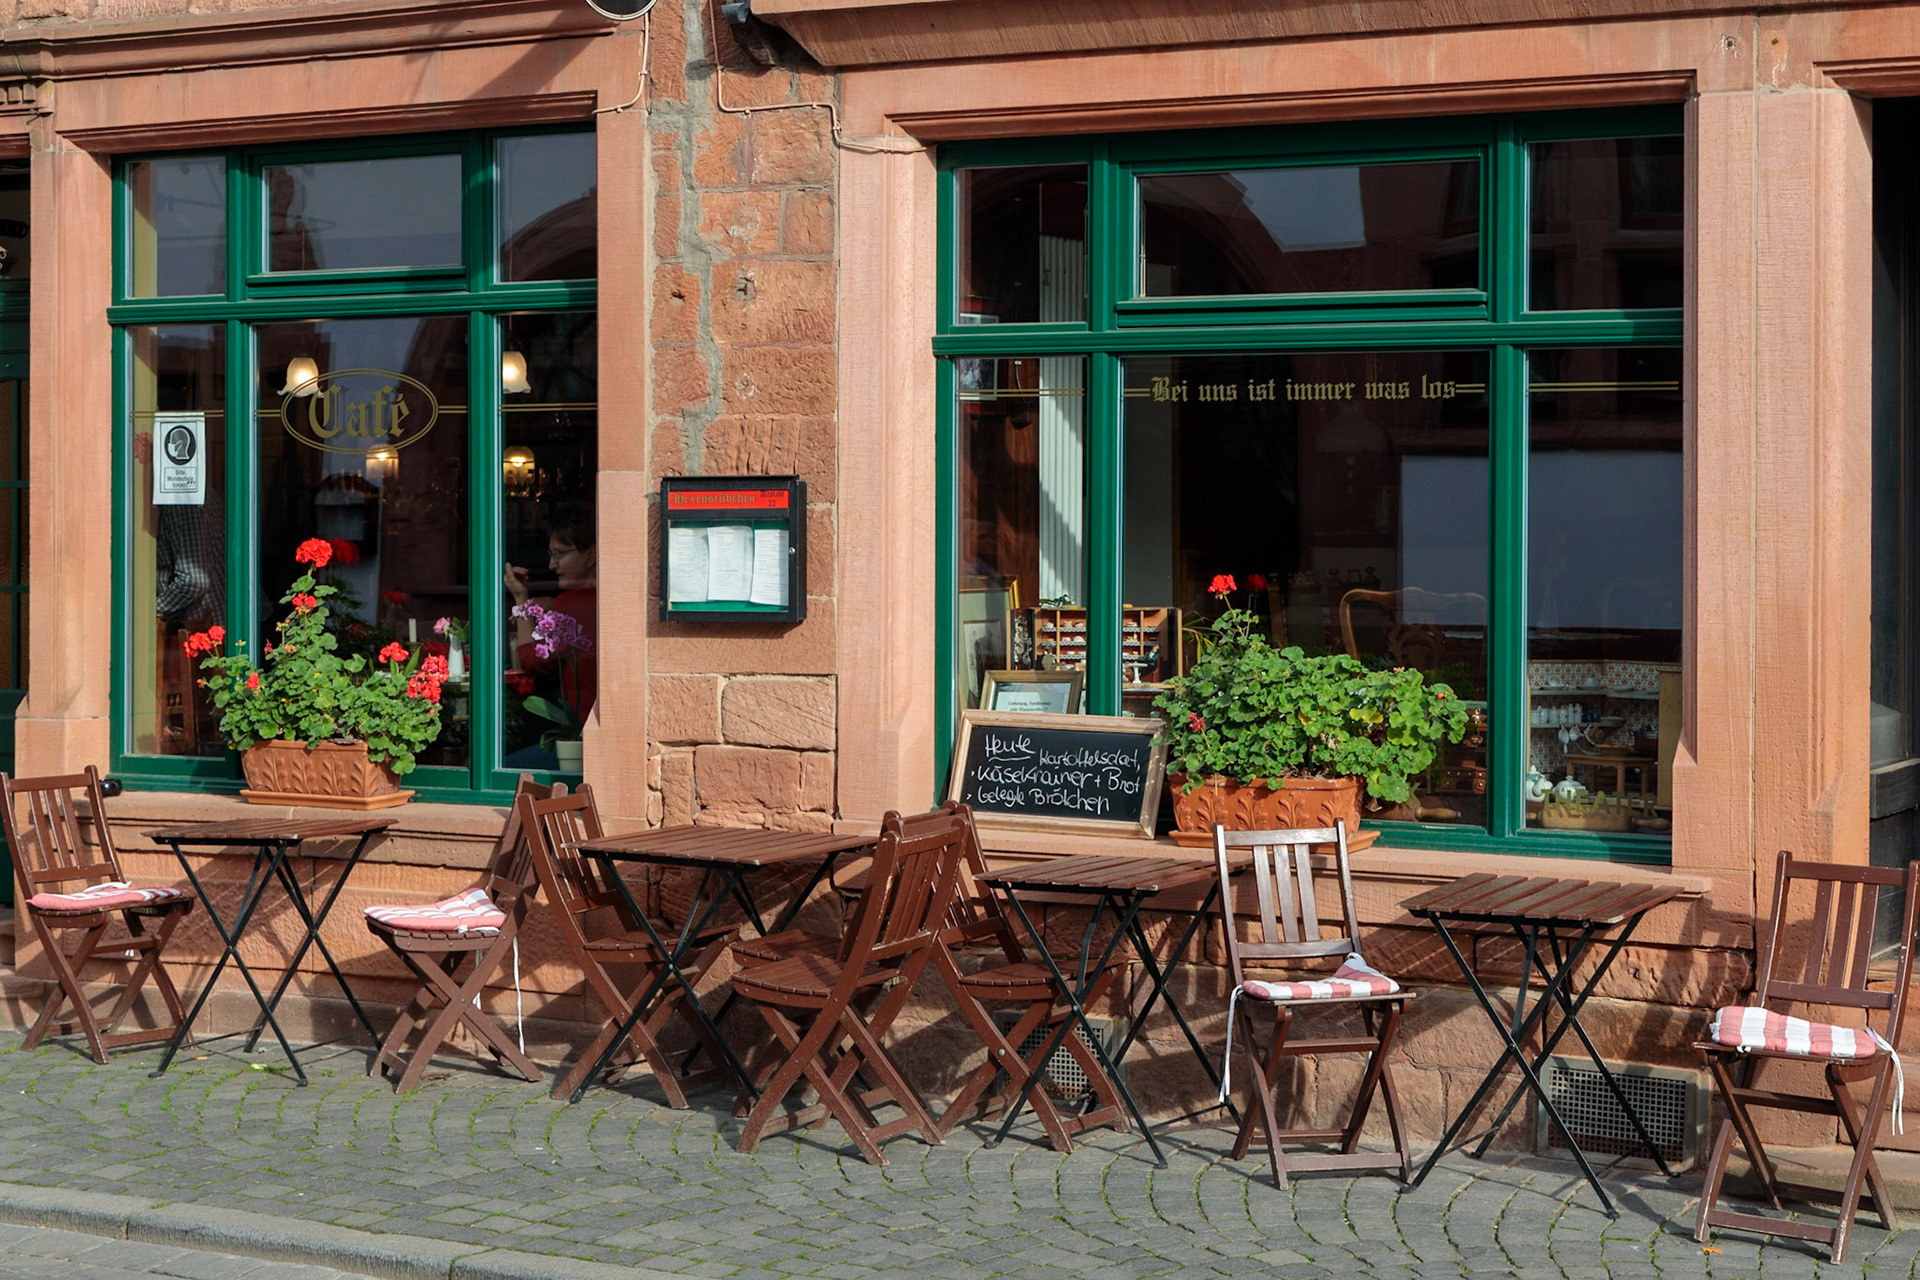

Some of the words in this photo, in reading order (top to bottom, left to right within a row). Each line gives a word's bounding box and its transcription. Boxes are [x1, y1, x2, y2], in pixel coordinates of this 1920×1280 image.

[1151, 376, 1188, 402] Bei
[1198, 384, 1238, 402] uns
[1248, 378, 1276, 401] ist
[1285, 378, 1356, 401] immer
[1365, 382, 1410, 400] was
[1421, 373, 1456, 399] los
[308, 384, 410, 438] Café
[674, 493, 756, 505] Hexenstübchen
[985, 734, 1036, 757] Heute
[1094, 773, 1101, 787] +
[1102, 767, 1141, 794] Brot
[1028, 788, 1111, 815] Brötchen
[1541, 788, 1659, 819] THEATER
